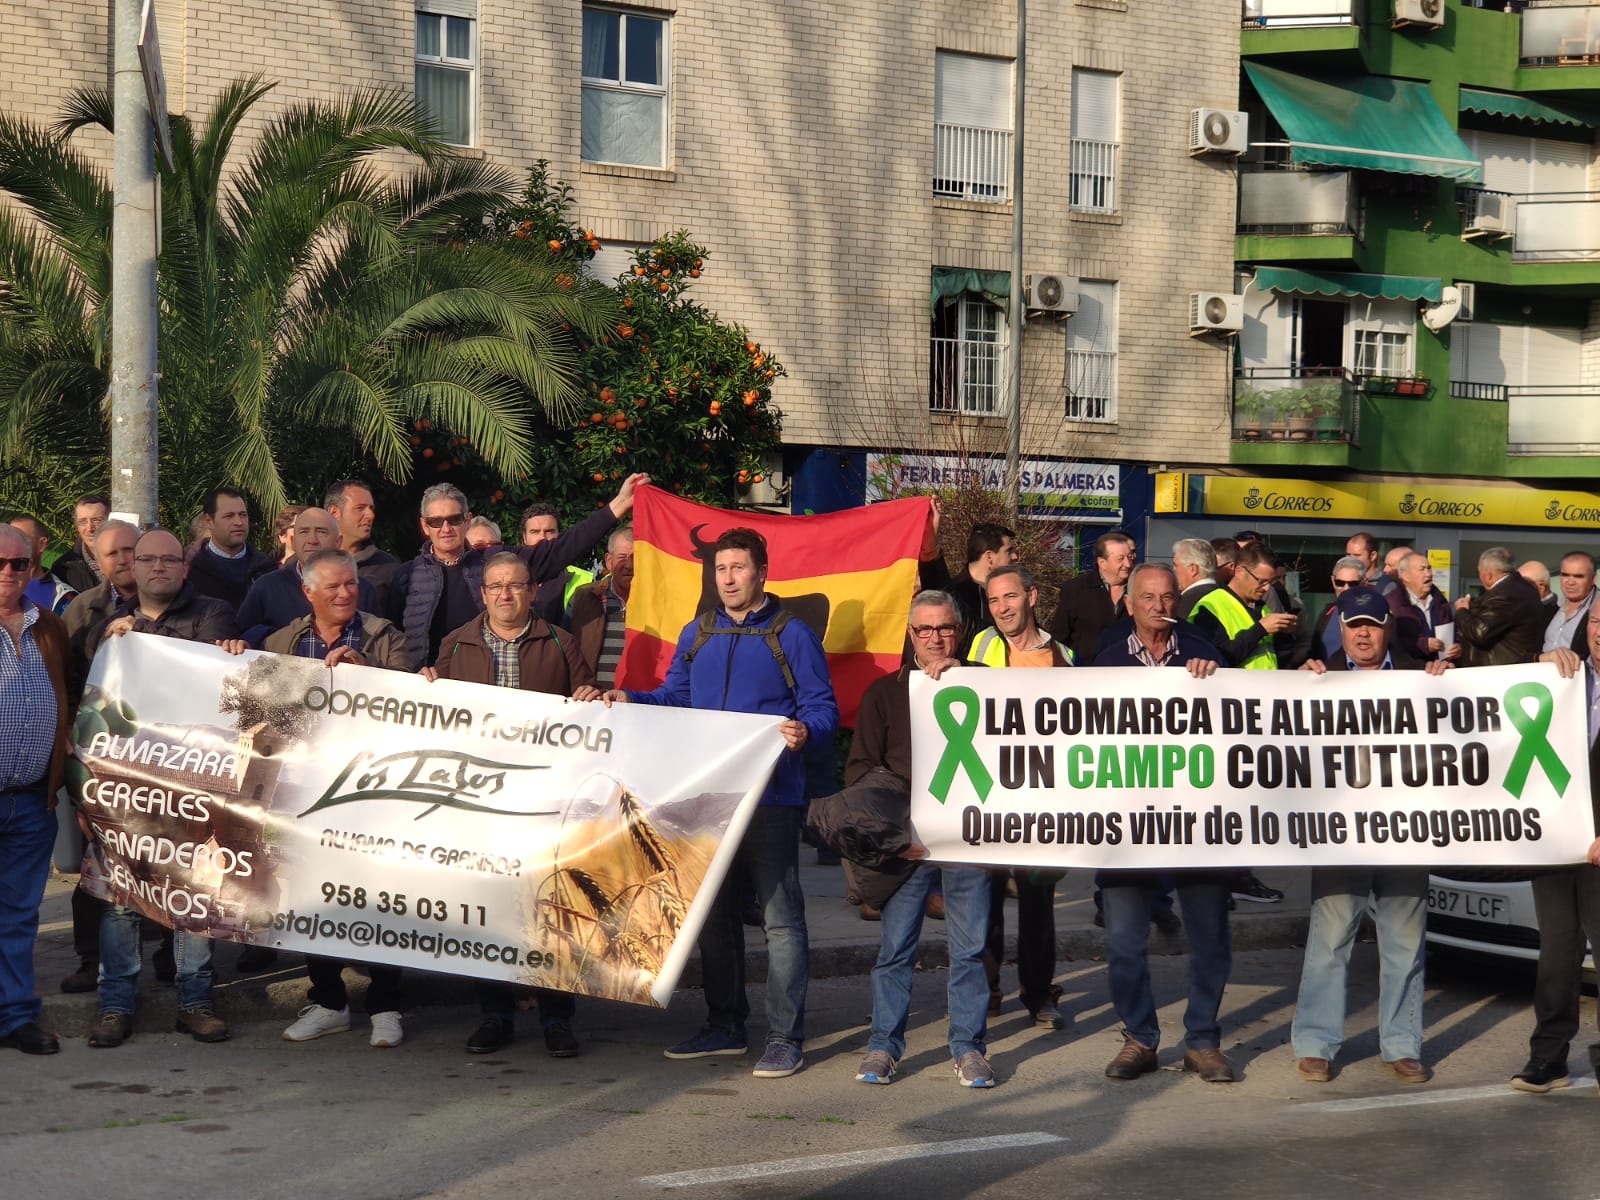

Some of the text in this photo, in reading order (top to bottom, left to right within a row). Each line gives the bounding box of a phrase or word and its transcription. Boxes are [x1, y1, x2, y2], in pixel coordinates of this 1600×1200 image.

[1003, 470, 1032, 489] LS
[1035, 472, 1116, 491] PALMERAS
[1087, 496, 1114, 506] cofan
[1263, 492, 1334, 512] CORREOS
[1418, 498, 1485, 517] CORREOS
[284, 684, 474, 730] OOPERATIVA
[985, 696, 1502, 736] LA COMARCA DE ALHAMA POR
[88, 731, 238, 779] ALMAZARA
[999, 741, 1490, 790] UN CAMPO CON FUTURO
[81, 778, 211, 823] CEREALES
[91, 821, 253, 877] GANADEROS
[962, 804, 1543, 849] Queremos vivir de lo que recogemos
[320, 881, 487, 927] 958 35 03 11
[1465, 894, 1503, 919] LCF
[250, 908, 555, 970] ostajos@lostajossca.es
